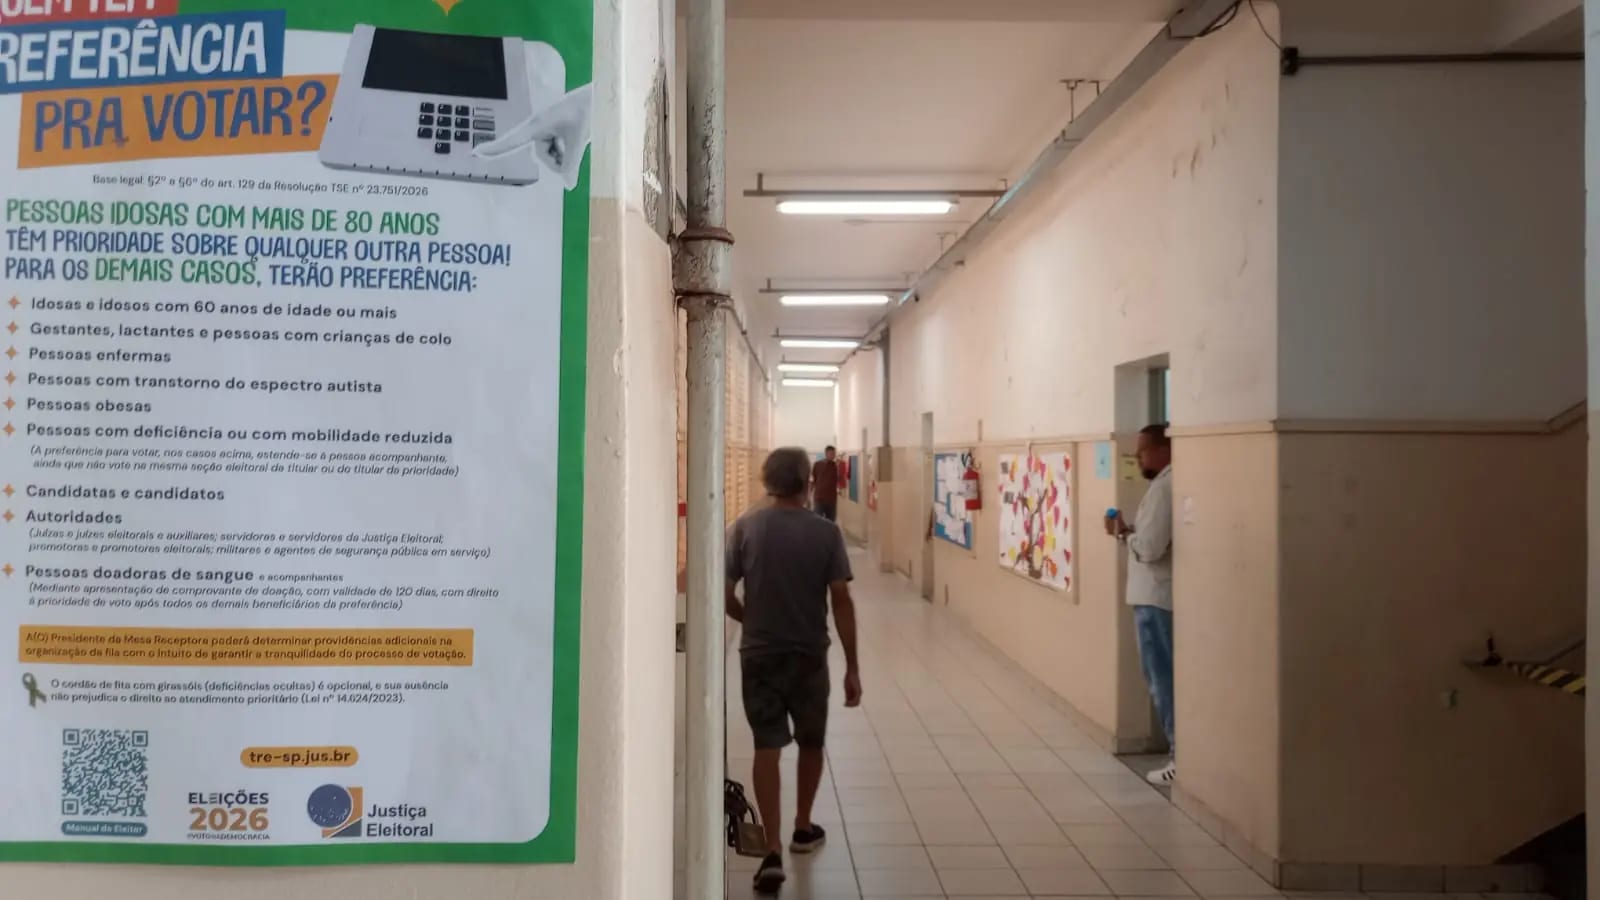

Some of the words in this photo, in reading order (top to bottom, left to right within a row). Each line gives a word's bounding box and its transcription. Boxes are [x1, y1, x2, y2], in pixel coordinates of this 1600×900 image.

[34, 97, 126, 151] PRA
[143, 80, 327, 142] VOTAR?
[6, 198, 104, 224] PESSOAS
[110, 202, 189, 226] IDOSAS
[196, 204, 245, 228] COM
[252, 206, 304, 230] MAIS
[312, 208, 337, 232] DE
[344, 210, 373, 233] 80
[380, 211, 440, 236] ANOS
[5, 227, 46, 252] TÊM
[53, 230, 164, 253] PRIORIDADE
[171, 232, 238, 256] SOBRE
[244, 236, 348, 264] QUALQUER
[354, 240, 421, 263] OUTRA
[428, 241, 511, 266] PESSOA!
[5, 258, 56, 281] PARA
[62, 260, 89, 281] OS
[95, 260, 174, 283] DEMAIS
[180, 260, 262, 288] CASOS,
[269, 264, 334, 288] TERÃO
[340, 266, 477, 293] PREFERÊNCIA:
[31, 297, 82, 310] Idosas
[86, 301, 95, 310] e
[99, 297, 150, 312] idosos
[154, 302, 190, 312] com
[194, 300, 216, 313] 60
[220, 304, 258, 315] anos
[262, 303, 283, 316] de
[287, 303, 332, 317] idade
[336, 308, 356, 318] ou
[360, 306, 397, 319] mais
[30, 322, 115, 338] Gestantes,
[119, 323, 194, 338] lactantes
[199, 328, 208, 338] e
[213, 329, 279, 342] pessoas
[284, 331, 318, 342] com
[323, 329, 391, 348] crianças
[395, 331, 414, 344] de
[419, 332, 452, 345] colo
[29, 346, 92, 361] Pessoas
[96, 348, 172, 363] enfermas
[28, 372, 91, 386] Pessoas
[96, 376, 130, 387] com
[134, 376, 220, 389] transtorno
[225, 376, 246, 390] do
[250, 380, 322, 394] espectro
[327, 380, 382, 393] autista
[27, 397, 90, 411] Pessoas
[95, 399, 152, 413] obesas
[26, 422, 90, 437] Pessoas
[95, 426, 129, 438] com
[133, 424, 223, 439] deficiência
[227, 430, 247, 440] ou
[252, 430, 287, 440] com
[291, 428, 380, 442] mobilidade
[385, 431, 452, 444] reduzida
[26, 484, 116, 499] Candidatas
[120, 489, 130, 499] e
[134, 486, 224, 500] candidatos
[25, 510, 122, 524] Autoridades
[25, 564, 88, 578] Pessoas
[93, 566, 166, 580] doadoras
[171, 568, 191, 580] de
[196, 570, 254, 584] sangue
[267, 573, 344, 584] acompanhantes
[249, 750, 351, 766] tre-sp.jus.br
[188, 789, 270, 808] ELEIÇÕES
[189, 807, 270, 832] 2026
[367, 804, 427, 820] Justiça
[65, 823, 99, 833] Manual
[366, 823, 434, 837] Eleitoral
